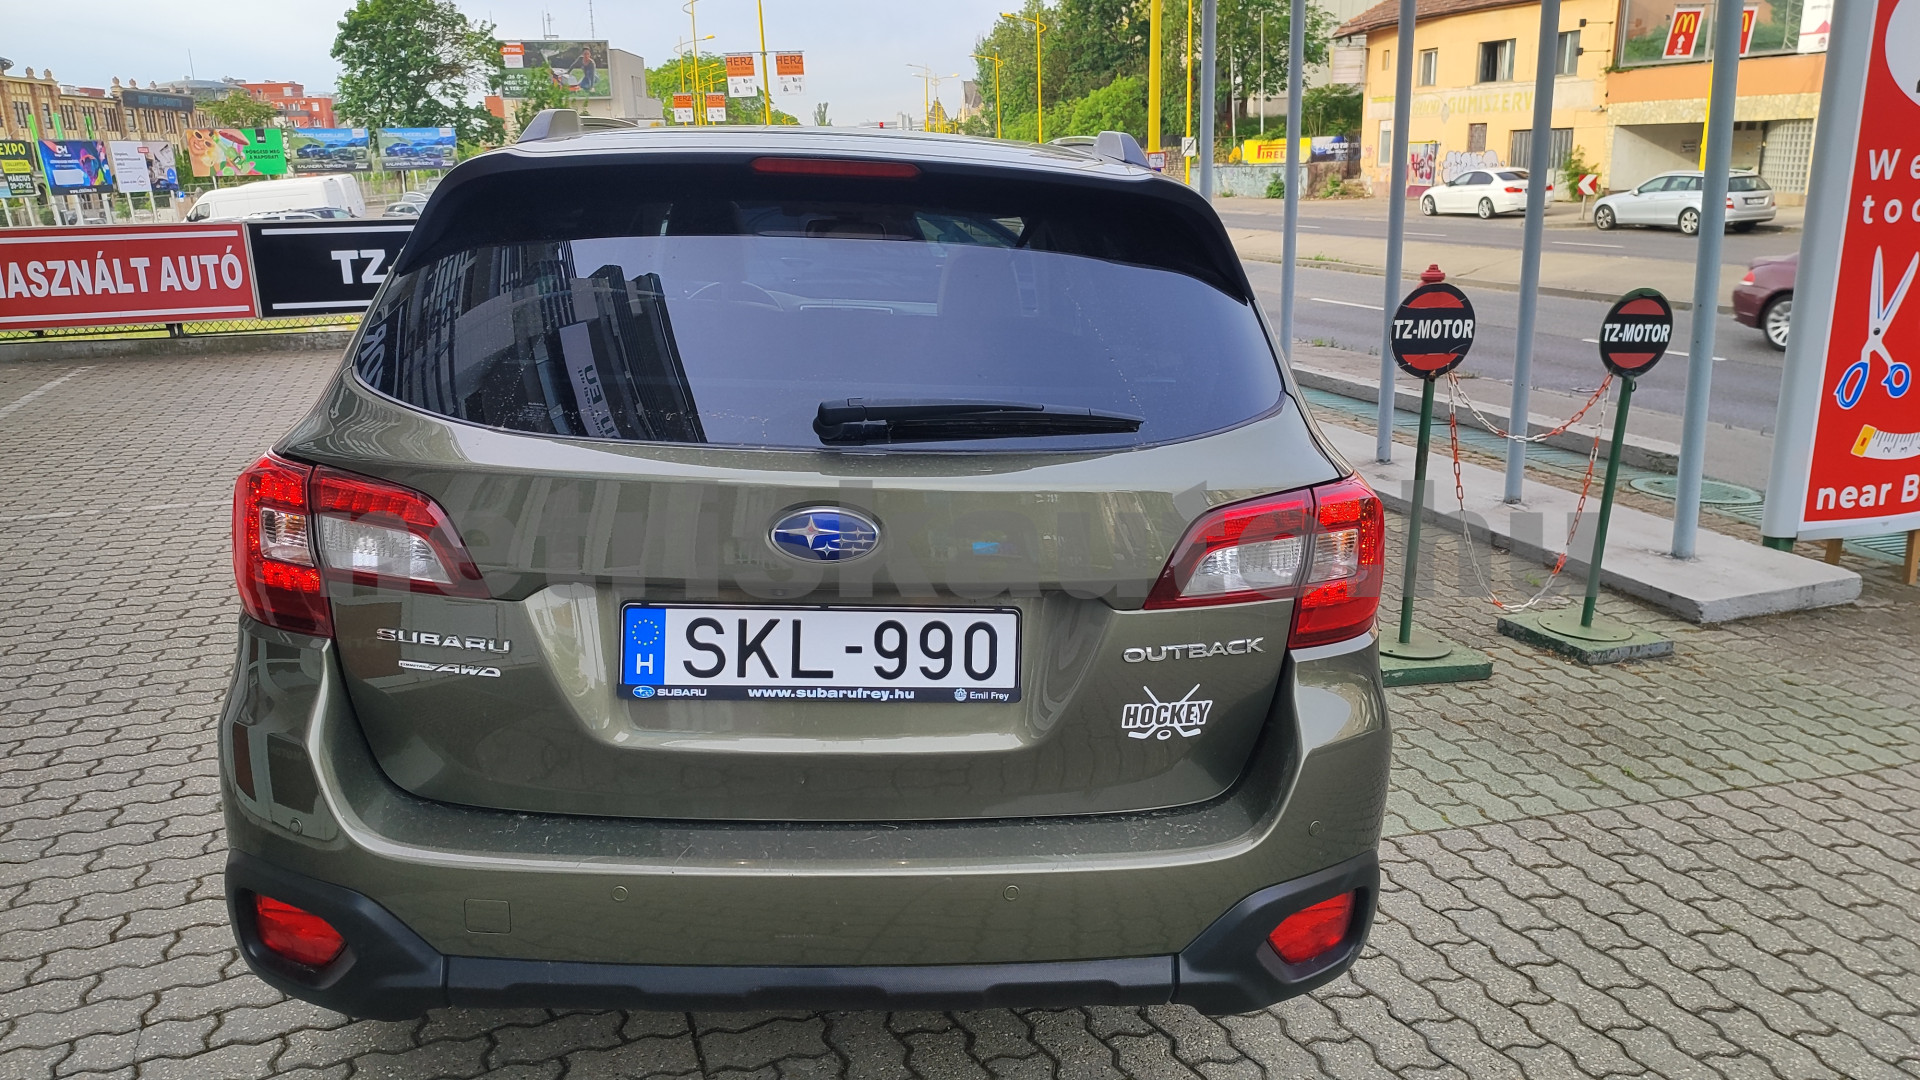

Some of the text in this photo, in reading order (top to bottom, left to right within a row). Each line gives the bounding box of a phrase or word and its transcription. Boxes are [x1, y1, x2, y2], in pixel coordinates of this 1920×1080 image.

[726, 57, 754, 66] HERZ
[776, 55, 803, 65] HERZ
[1448, 91, 1533, 114] GUMISZERV
[1257, 145, 1286, 159] PIREL
[160, 245, 243, 292] AUTÓ
[330, 248, 392, 285] TZ
[1394, 319, 1474, 339] TZ-MOTOR
[1603, 323, 1671, 343] TZ-MOTOR
[1816, 482, 1892, 510] near
[376, 628, 512, 654] SUBARU
[1122, 637, 1266, 663] OUTBACK
[435, 663, 501, 678] AWD
[635, 653, 653, 675] H
[657, 688, 708, 697] SUBARU
[747, 686, 915, 701] www.subarufrey.hu
[969, 691, 1010, 701] Emil Frey
[1122, 700, 1213, 728] HOCKEY
